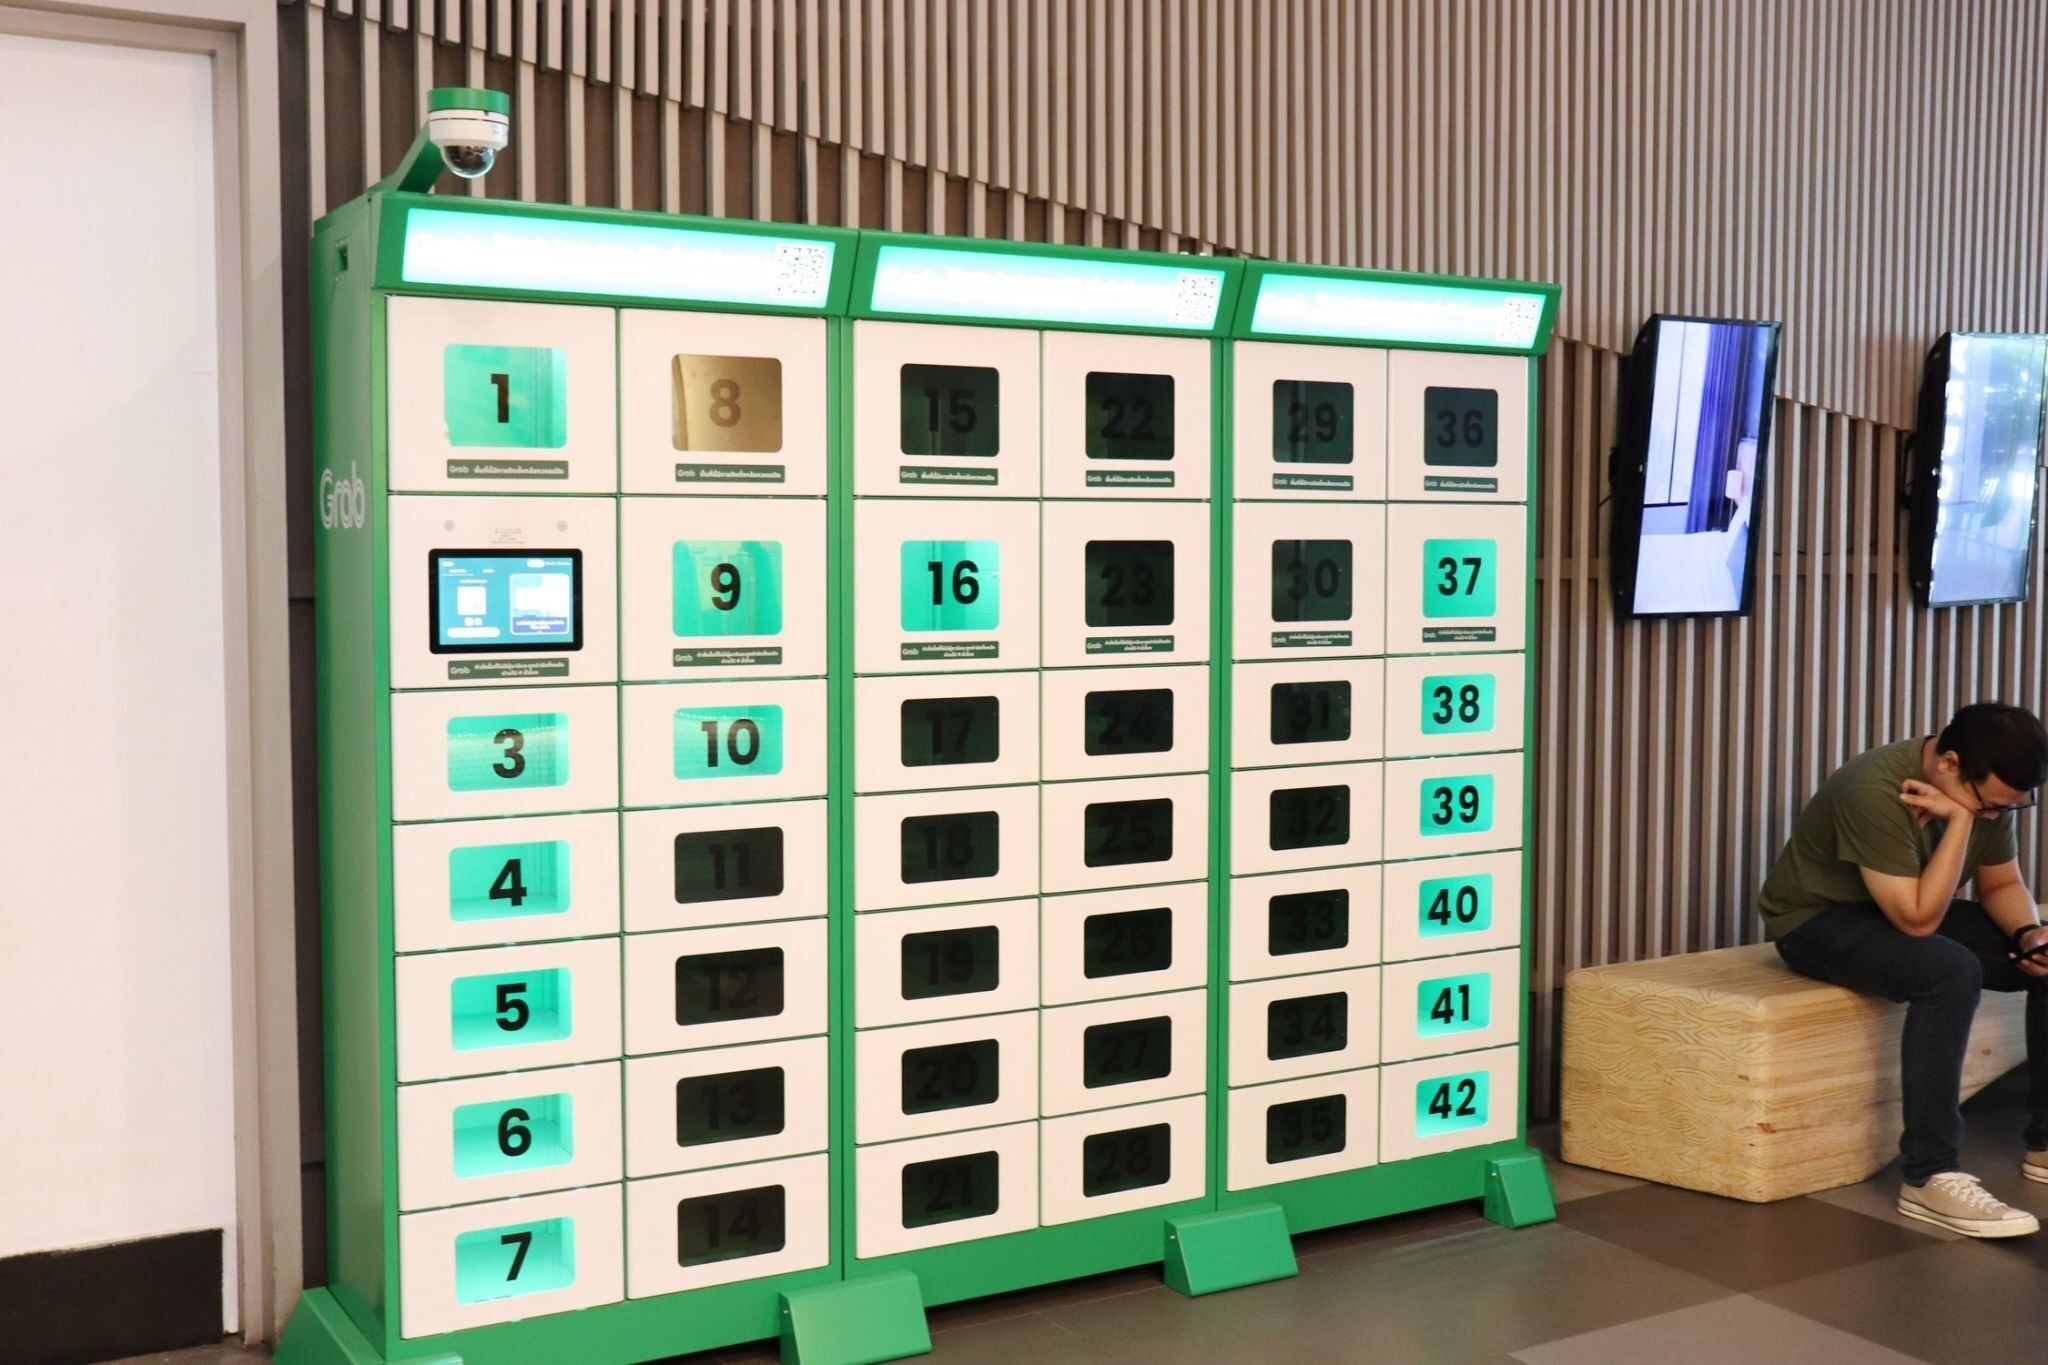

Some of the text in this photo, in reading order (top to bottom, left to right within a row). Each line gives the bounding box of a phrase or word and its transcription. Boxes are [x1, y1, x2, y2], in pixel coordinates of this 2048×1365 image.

[490, 373, 510, 423] 1
[709, 378, 741, 427] 8
[924, 387, 976, 433] 15
[1101, 397, 1155, 440] 22
[1436, 408, 1484, 448] 36
[449, 465, 469, 473] Grab
[319, 460, 366, 529] Grab
[711, 563, 741, 611] 9
[928, 560, 979, 605] 16
[1101, 563, 1155, 608] 23
[1287, 558, 1339, 601] 30
[1437, 557, 1482, 596] 37
[450, 666, 470, 674] Grab
[675, 654, 693, 662] Grab
[1432, 684, 1479, 724] 38
[492, 728, 526, 778] 3
[701, 718, 760, 768] 10
[926, 708, 975, 755] 17
[1286, 796, 1336, 839] 32
[1432, 785, 1479, 825] 39
[707, 841, 752, 890] 11
[921, 822, 974, 869] 18
[488, 858, 527, 906] 4
[1427, 886, 1478, 925] 40
[924, 937, 975, 986] 19
[496, 982, 529, 1032] 5
[703, 962, 759, 1011] 12
[1430, 984, 1470, 1024] 41
[1283, 1003, 1335, 1046] 34
[1098, 1029, 1151, 1075] 27
[916, 1051, 979, 1101] 20
[1428, 1079, 1476, 1119] 42
[703, 1079, 758, 1130] 13
[497, 1107, 532, 1157] 6
[1095, 1135, 1150, 1184] 28
[925, 1163, 974, 1213] 21
[702, 1198, 762, 1248] 14
[500, 1231, 532, 1281] 7
